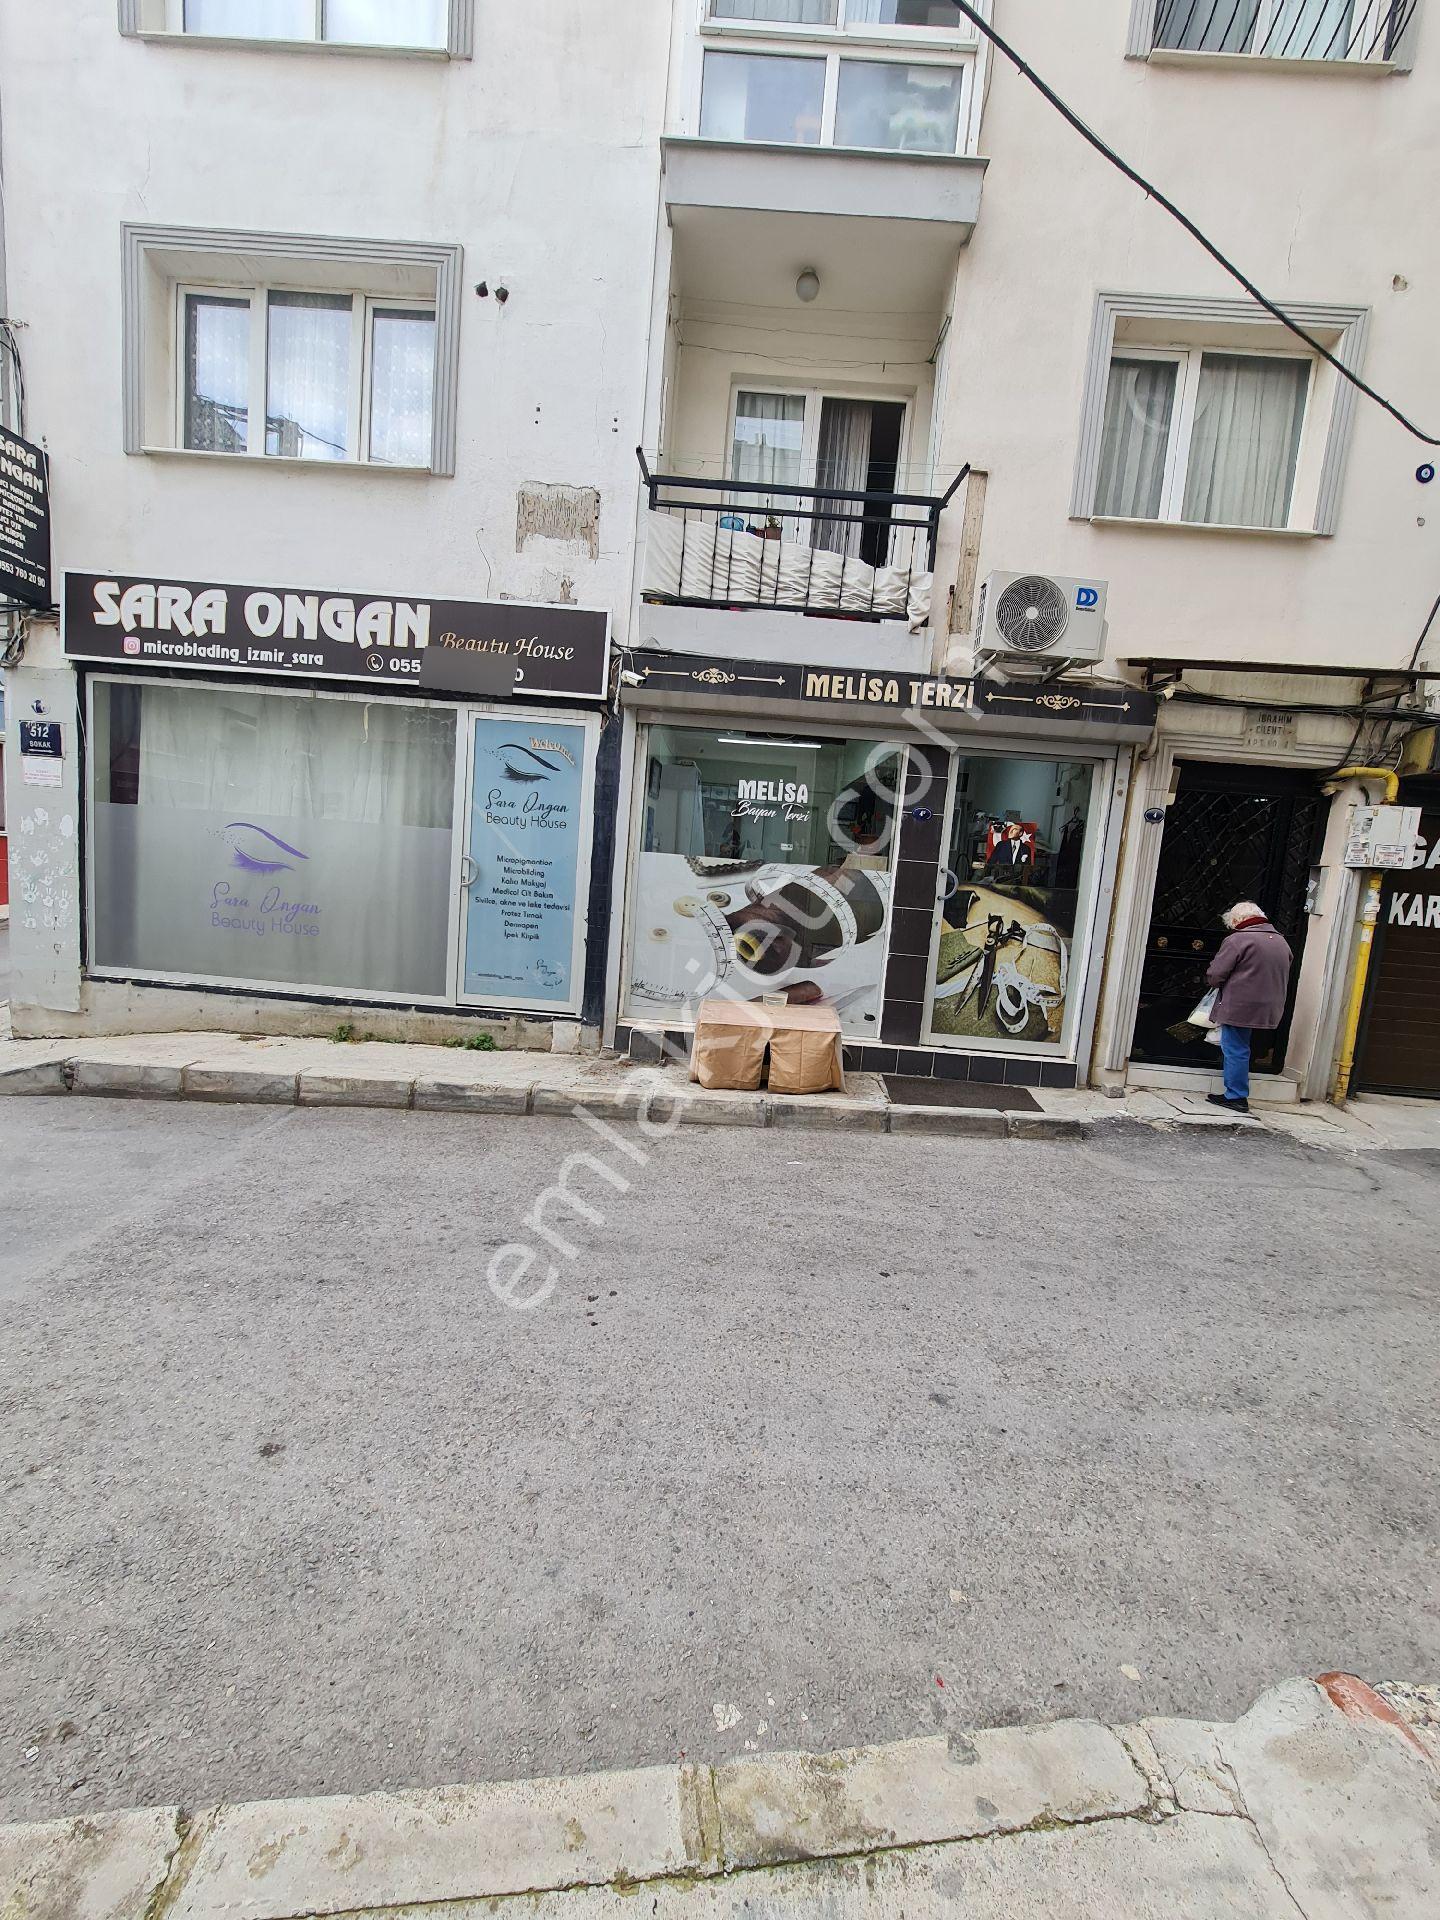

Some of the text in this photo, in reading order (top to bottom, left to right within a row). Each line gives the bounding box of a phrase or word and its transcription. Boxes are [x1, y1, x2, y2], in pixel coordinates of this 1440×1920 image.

[0, 434, 37, 470] SARA
[0, 456, 44, 494] NGAN
[92, 580, 431, 650] SARA ONGAN
[143, 640, 324, 667] microblading_izmir_sara
[513, 635, 574, 661] House
[389, 657, 421, 673] 055
[805, 672, 975, 709] MELİSA TERZİ
[29, 726, 49, 738] 512
[29, 740, 51, 748] SOKAK
[485, 788, 570, 820] Sara Ongan
[737, 778, 809, 804] MELİSA
[486, 811, 567, 830] Beauty House
[731, 800, 811, 824] Bayan Terzi
[520, 878, 547, 889] Makyaj
[210, 881, 321, 923] Sara Ongan
[499, 899, 517, 907] akne
[211, 911, 320, 936] Beauty House
